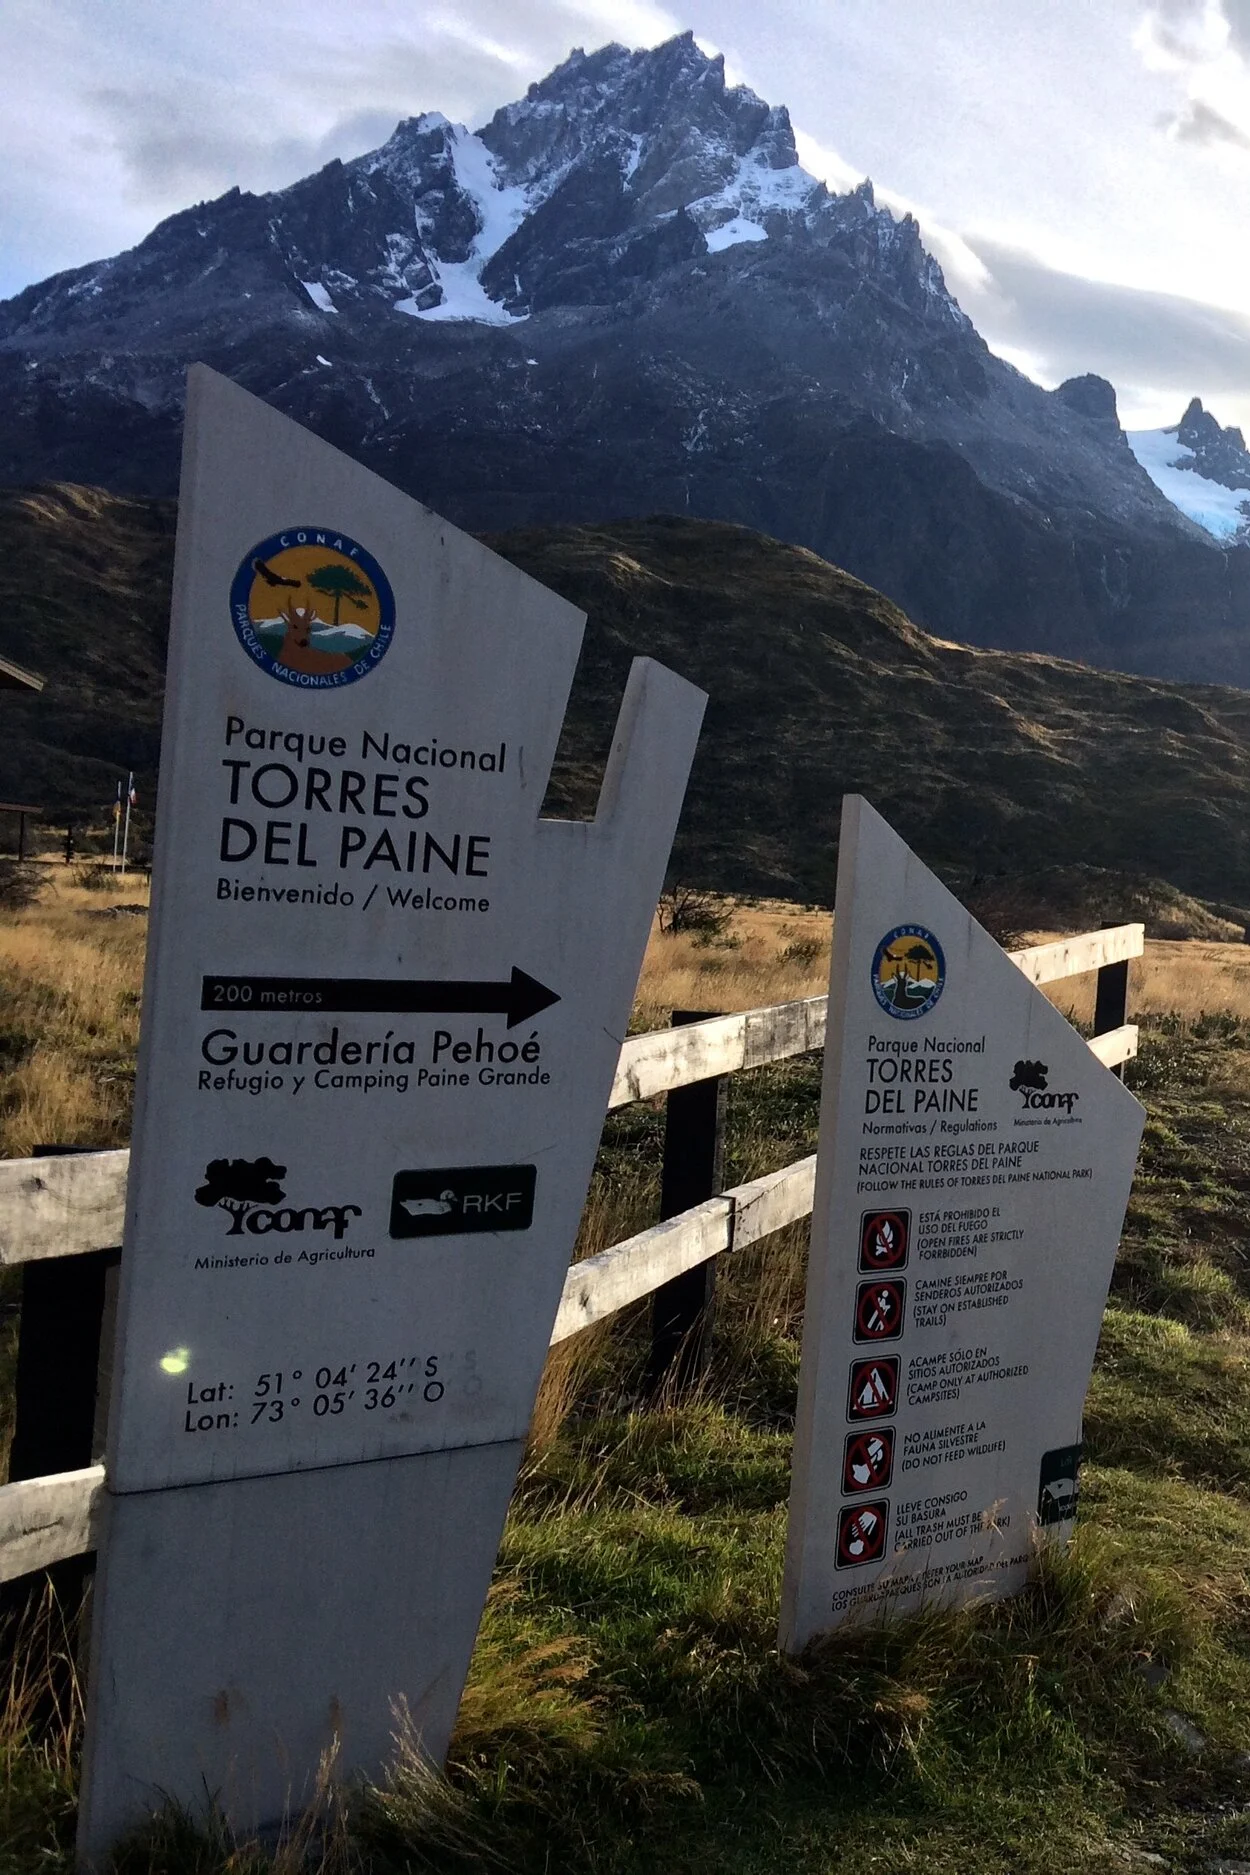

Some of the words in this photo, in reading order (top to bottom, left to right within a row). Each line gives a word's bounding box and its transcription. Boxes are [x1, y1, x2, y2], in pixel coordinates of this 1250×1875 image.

[280, 532, 359, 557] CONAF
[235, 604, 267, 660] PARQUES
[272, 662, 347, 686] NACIONALES
[354, 660, 370, 675] DE
[370, 624, 391, 658] CHILE
[225, 716, 346, 762] Parque
[362, 731, 506, 773] Nacional
[221, 759, 430, 819] TORRES
[219, 817, 317, 867] DEL
[339, 828, 491, 877] PAINE
[216, 879, 354, 907] Bienvenido
[387, 887, 490, 912] Welcome
[214, 985, 252, 1003] 200
[260, 987, 323, 1004] metros
[201, 1028, 415, 1066] Guardería
[432, 1029, 541, 1064] Pehoé
[868, 1035, 918, 1057] Parque
[923, 1036, 986, 1054] Nacional
[198, 1070, 284, 1095] Refugio
[292, 1074, 305, 1096] y
[314, 1069, 408, 1093] Camping
[417, 1068, 469, 1087] Paine
[478, 1066, 551, 1086] Grande
[866, 1058, 953, 1083] TORRES
[865, 1090, 906, 1114] DEL
[914, 1089, 978, 1113] PAINE
[862, 1121, 927, 1136] Normativas
[940, 1119, 998, 1137] Regulations
[860, 1146, 906, 1161] RESPETE
[910, 1146, 931, 1159] LAS
[934, 1144, 975, 1157] REGLAS
[978, 1143, 996, 1155] DEL
[999, 1140, 1040, 1154] PARQUE
[859, 1160, 924, 1176] NACIONAL
[928, 1158, 968, 1173] TORRES
[972, 1157, 989, 1170] DEL
[992, 1155, 1023, 1169] PAINE
[857, 1179, 898, 1194] (FOLLOW
[901, 1179, 917, 1190] THE
[919, 1177, 945, 1189] RULES
[947, 1176, 959, 1187] OF
[961, 1174, 991, 1186] TORRES
[992, 1173, 1006, 1184] DEL
[1008, 1171, 1031, 1183] PAINE
[1032, 1170, 1070, 1181] NATIONAL
[1072, 1168, 1093, 1179] PARK)
[462, 1192, 523, 1213] RKF
[919, 1209, 941, 1223] ESTÁ
[943, 1209, 989, 1221] PROHIBIDO
[992, 1207, 1001, 1217] EL
[918, 1223, 938, 1235] USO
[941, 1222, 957, 1233] DEL
[958, 1220, 988, 1232] FUEGO
[917, 1233, 946, 1250] (OPEN
[948, 1232, 970, 1246] FIRES
[972, 1232, 988, 1244] ARE
[990, 1229, 1024, 1242] STRICTLY
[194, 1252, 269, 1270] Ministerio
[274, 1251, 292, 1265] de
[298, 1247, 376, 1267] Agricultura
[914, 1287, 962, 1302] SENDEROS
[963, 1279, 1024, 1296] AUTORIZADOS
[915, 1277, 952, 1290] CAMINE
[954, 1272, 988, 1286] SIEMPRE
[991, 1270, 1008, 1281] POR
[913, 1304, 938, 1318] (STAY
[940, 1302, 956, 1314] ON
[957, 1295, 1009, 1312] ESTABLISHED
[915, 1313, 947, 1328] TRAILS)
[908, 1353, 947, 1368] ACAMPE
[949, 1348, 973, 1363] SÓLO
[975, 1347, 987, 1358] EN
[908, 1367, 937, 1380] SITIOS
[939, 1356, 1000, 1376] AUTORIZADOS
[188, 1382, 234, 1404] Lat:
[424, 1356, 438, 1377] S
[906, 1381, 938, 1396] (CAMP
[940, 1376, 963, 1389] ONLY
[965, 1374, 976, 1384] AT
[977, 1365, 1029, 1383] AUTHORIZED
[908, 1388, 960, 1406] CAMPSITES)
[184, 1410, 239, 1432] Lon:
[904, 1432, 921, 1444] NO
[967, 1423, 974, 1433] A
[976, 1421, 986, 1431] LA
[903, 1442, 936, 1456] FAUNA
[938, 1432, 979, 1450] SILVESTRE
[901, 1458, 920, 1472] (DO
[922, 1453, 942, 1466] NOT
[944, 1449, 964, 1462] FEED
[896, 1501, 922, 1516] LLEVE
[924, 1490, 968, 1509] CONSIGO
[895, 1515, 908, 1527] SU
[911, 1507, 947, 1524] BASURA
[916, 1518, 944, 1537] TRASH
[946, 1513, 970, 1529] MUST
[971, 1510, 983, 1523] BE
[935, 1530, 953, 1544] OUT
[955, 1526, 968, 1538] OF
[832, 1599, 848, 1612] LOS
